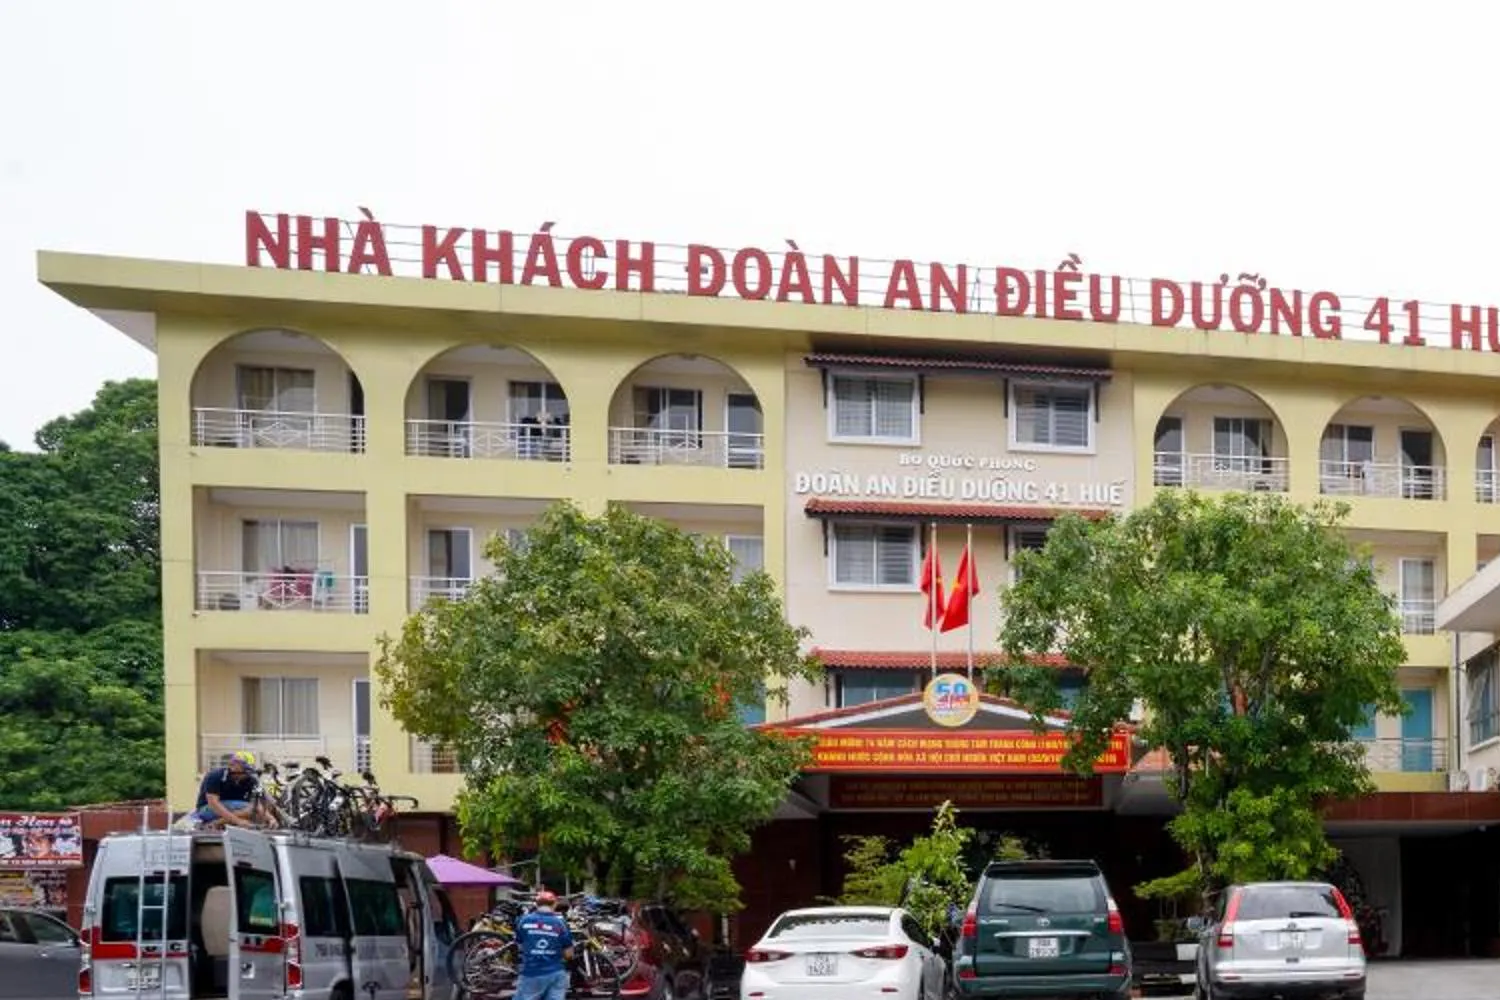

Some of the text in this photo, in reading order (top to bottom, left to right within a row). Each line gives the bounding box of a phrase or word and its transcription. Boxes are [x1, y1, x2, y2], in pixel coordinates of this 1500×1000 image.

[246, 206, 393, 276] NHÀ
[421, 221, 655, 293] KHÁCH
[685, 239, 859, 307] ĐOÀN
[884, 259, 967, 313] AN
[994, 253, 1121, 323] ĐIỀU
[1151, 273, 1342, 340] DƯỠNG
[1363, 297, 1426, 346] 41
[865, 475, 898, 498] AN
